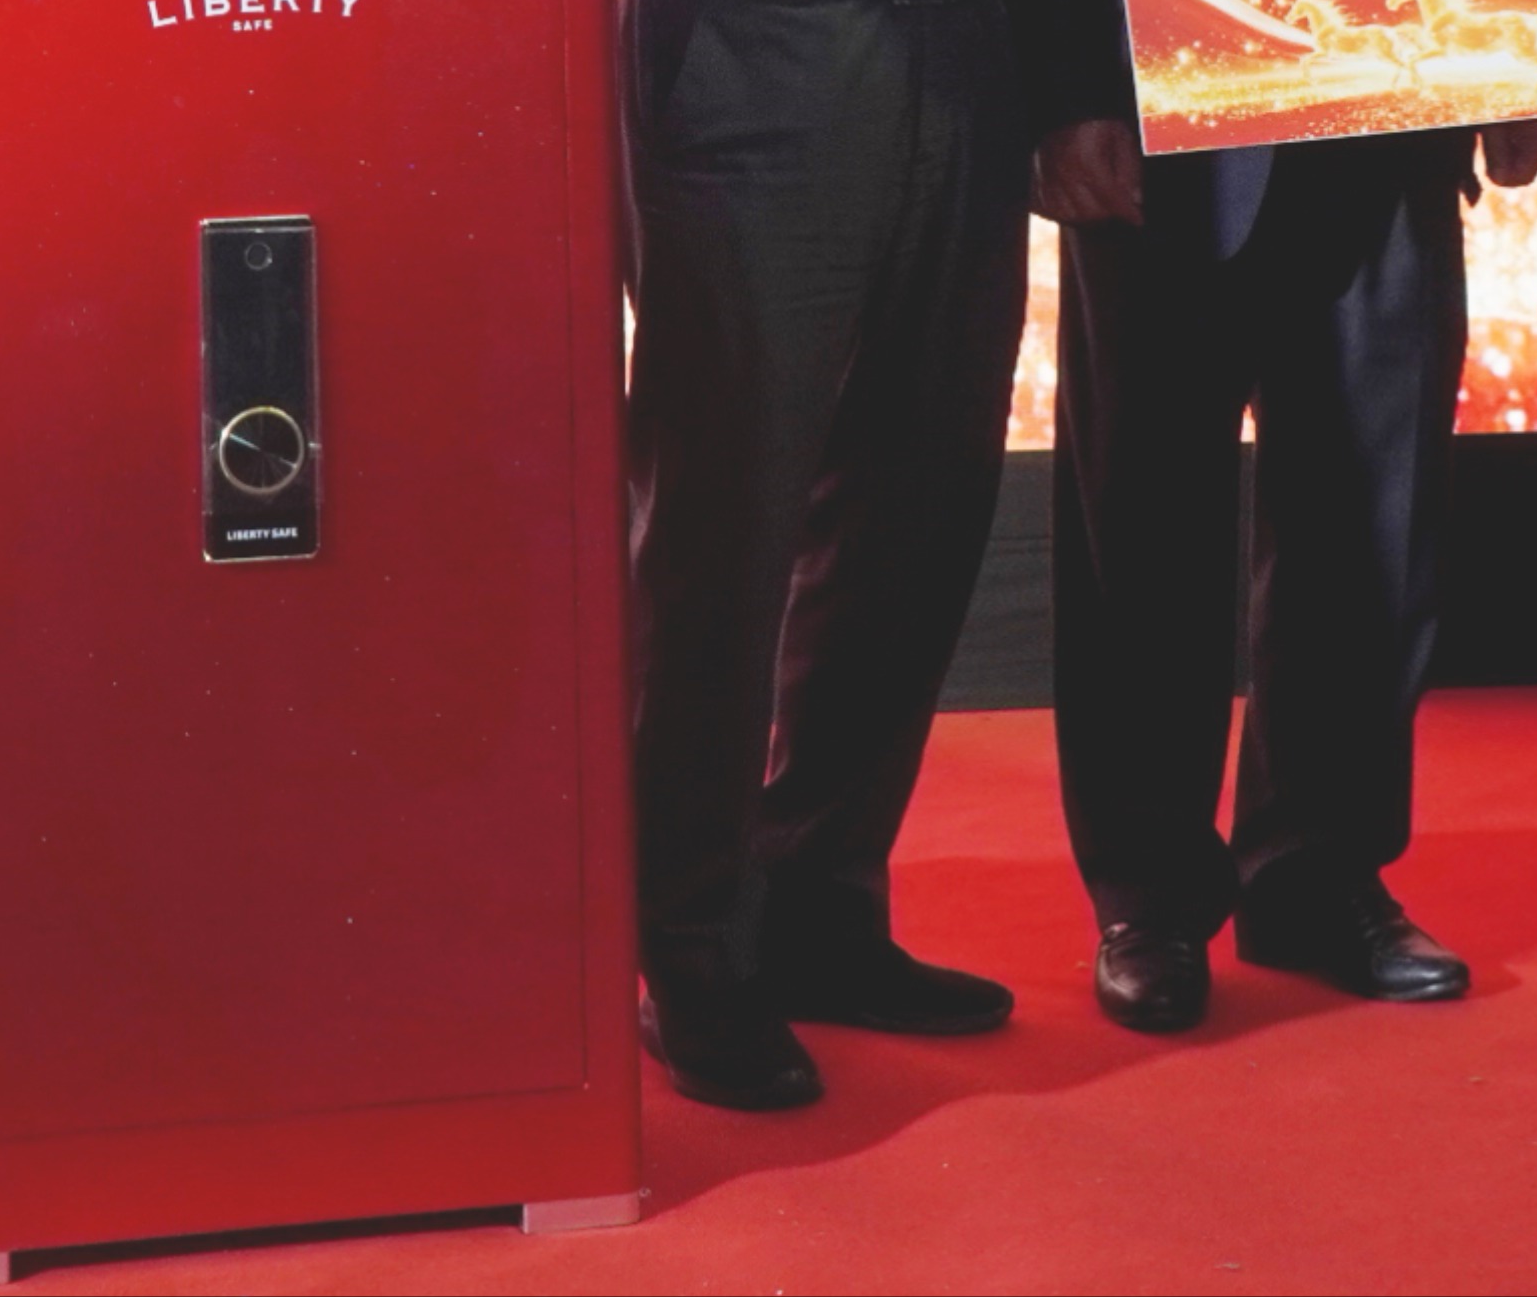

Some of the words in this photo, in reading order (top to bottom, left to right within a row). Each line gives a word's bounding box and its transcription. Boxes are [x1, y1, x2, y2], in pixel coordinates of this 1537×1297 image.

[232, 19, 273, 32] SAFE
[226, 528, 270, 541] LIBERTY
[271, 527, 299, 539] SAFE
